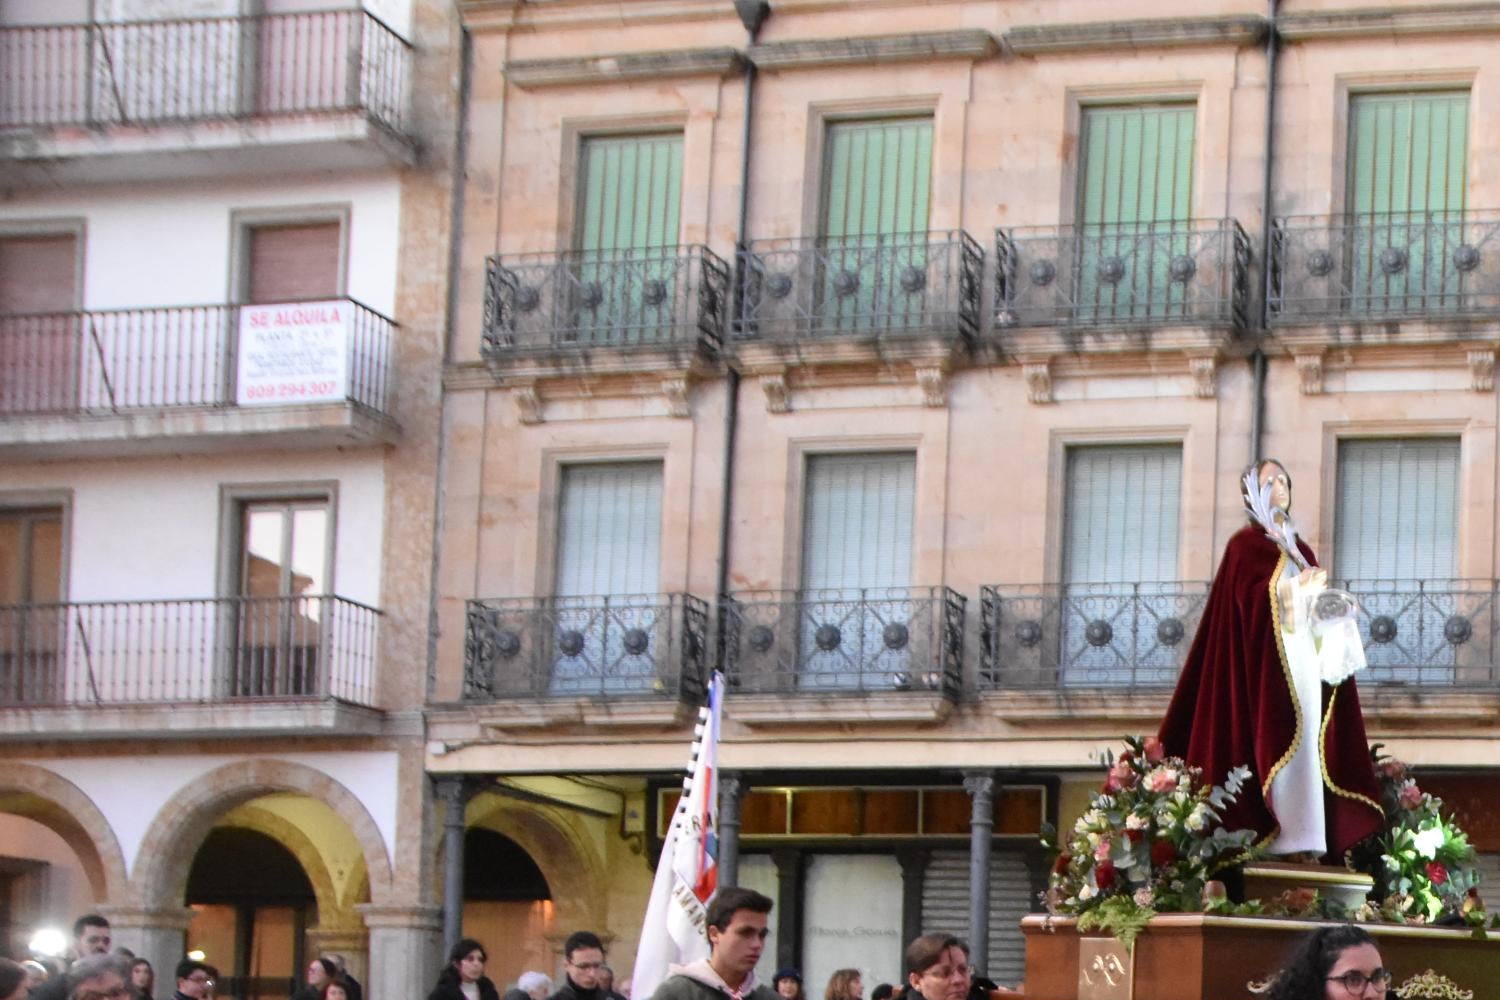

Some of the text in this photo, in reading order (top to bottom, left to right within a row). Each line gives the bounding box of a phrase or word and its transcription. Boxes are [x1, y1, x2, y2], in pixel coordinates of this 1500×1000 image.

[250, 308, 341, 327] SE ALQUILA
[279, 383, 305, 396] 294
